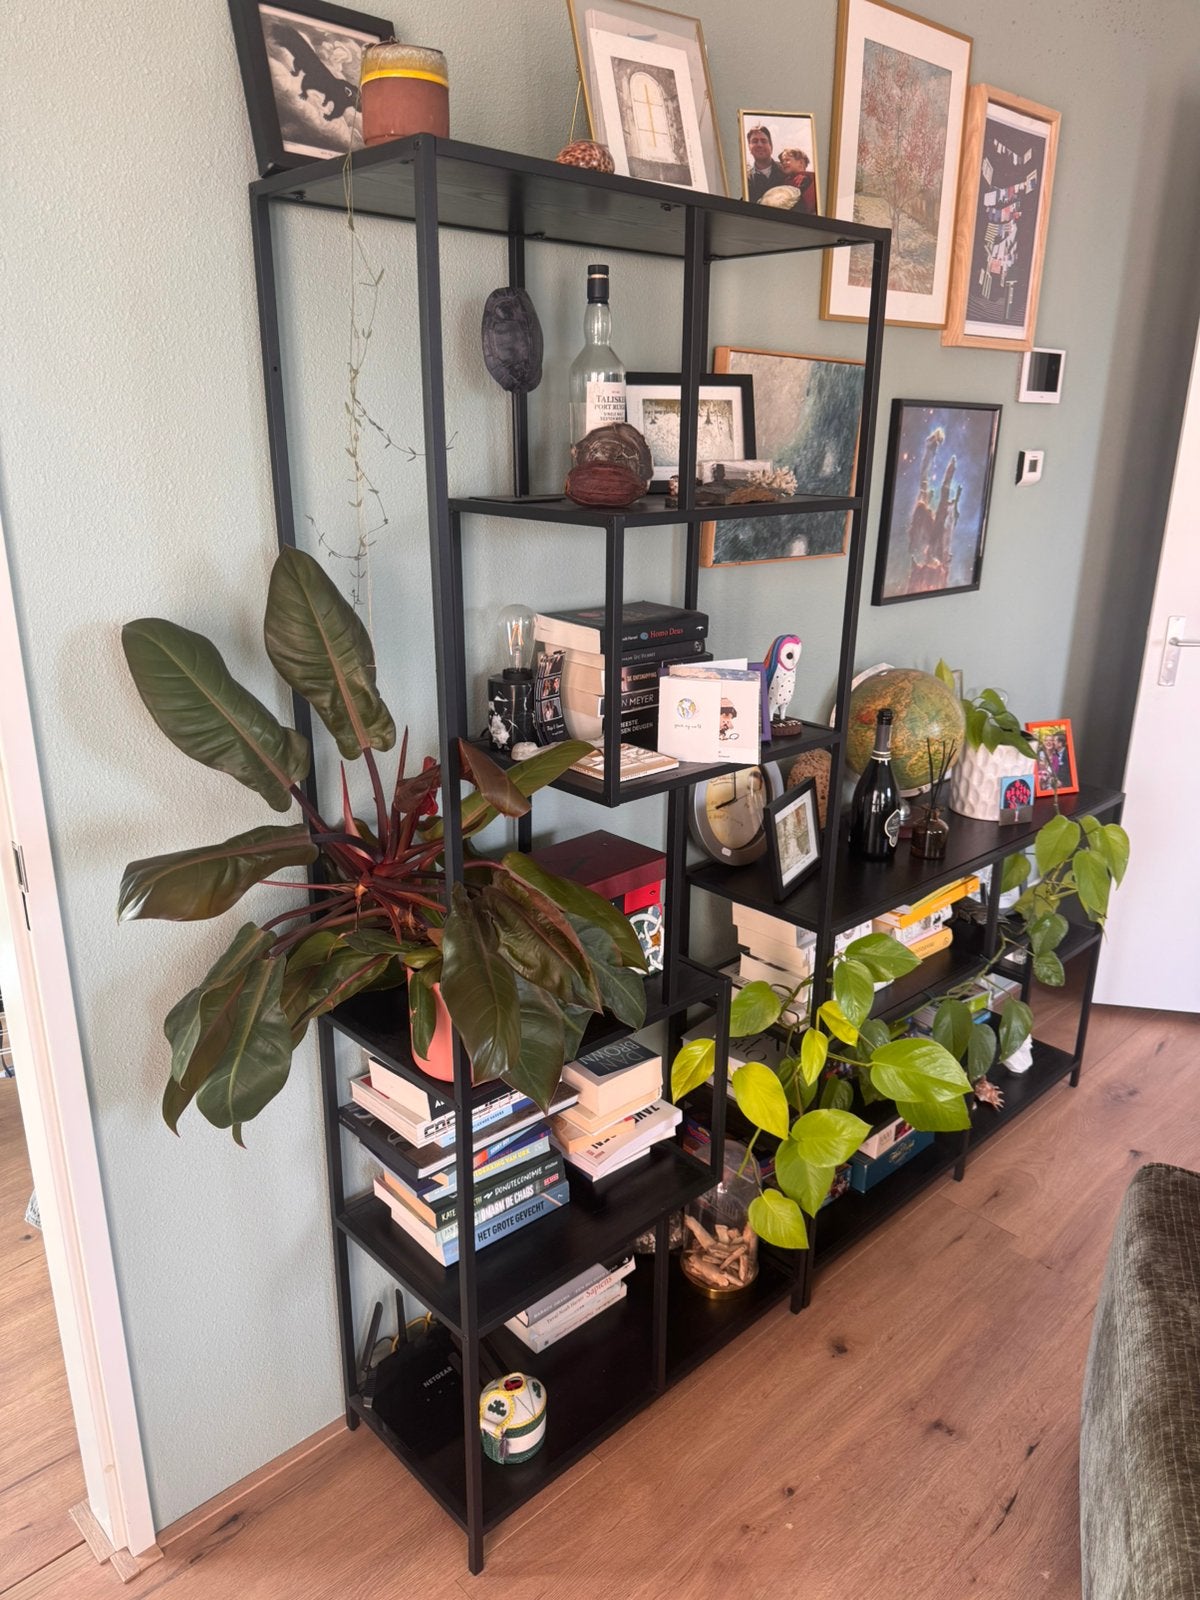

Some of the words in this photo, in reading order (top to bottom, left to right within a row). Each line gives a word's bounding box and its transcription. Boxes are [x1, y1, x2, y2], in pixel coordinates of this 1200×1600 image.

[596, 395, 625, 403] TALISKE
[650, 630, 668, 639] Homo
[669, 627, 684, 635] Deus
[629, 694, 654, 706] MEYER
[632, 722, 653, 731] DEUGEN
[578, 1040, 640, 1065] BROWN
[598, 1050, 645, 1071] DAN
[504, 1153, 517, 1164] VAN
[441, 1208, 457, 1222] KATE
[494, 1167, 543, 1196] DONUTECONOMIE
[505, 1196, 514, 1209] DE
[514, 1184, 535, 1203] CHAOS
[477, 1227, 492, 1242] HET
[492, 1216, 515, 1234] GROTE
[515, 1200, 545, 1223] GEVECHT
[585, 1276, 613, 1298] Sapiens
[423, 1366, 454, 1388] NETGEAR
